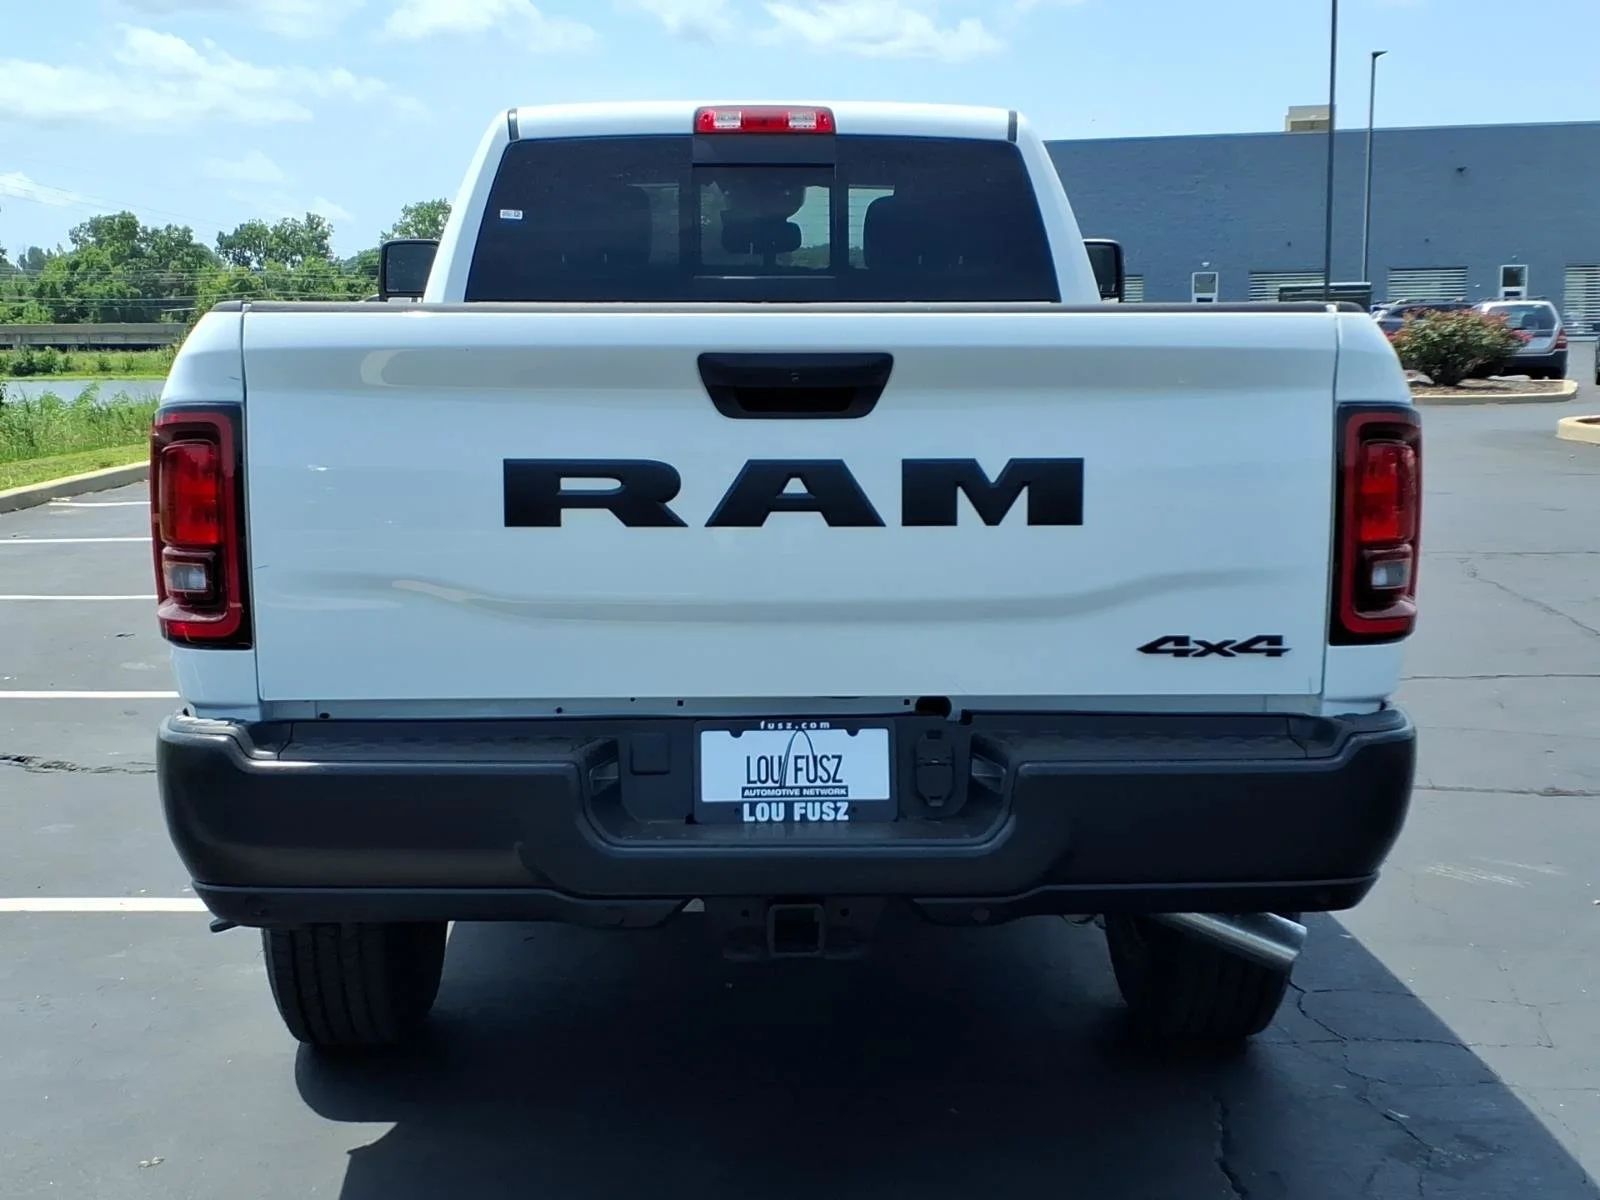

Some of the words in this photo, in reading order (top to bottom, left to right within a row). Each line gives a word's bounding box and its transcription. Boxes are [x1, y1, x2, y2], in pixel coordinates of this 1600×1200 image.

[503, 458, 1084, 528] RAM
[1137, 635, 1292, 657] 4x4
[760, 721, 830, 729] fusz.com
[747, 755, 782, 784] LOU
[794, 755, 843, 784] FUSZ
[743, 788, 800, 797] AUTOMOTIVE
[802, 787, 847, 796] NETWORK
[743, 803, 785, 822] LOU
[794, 801, 849, 821] FUSZ
